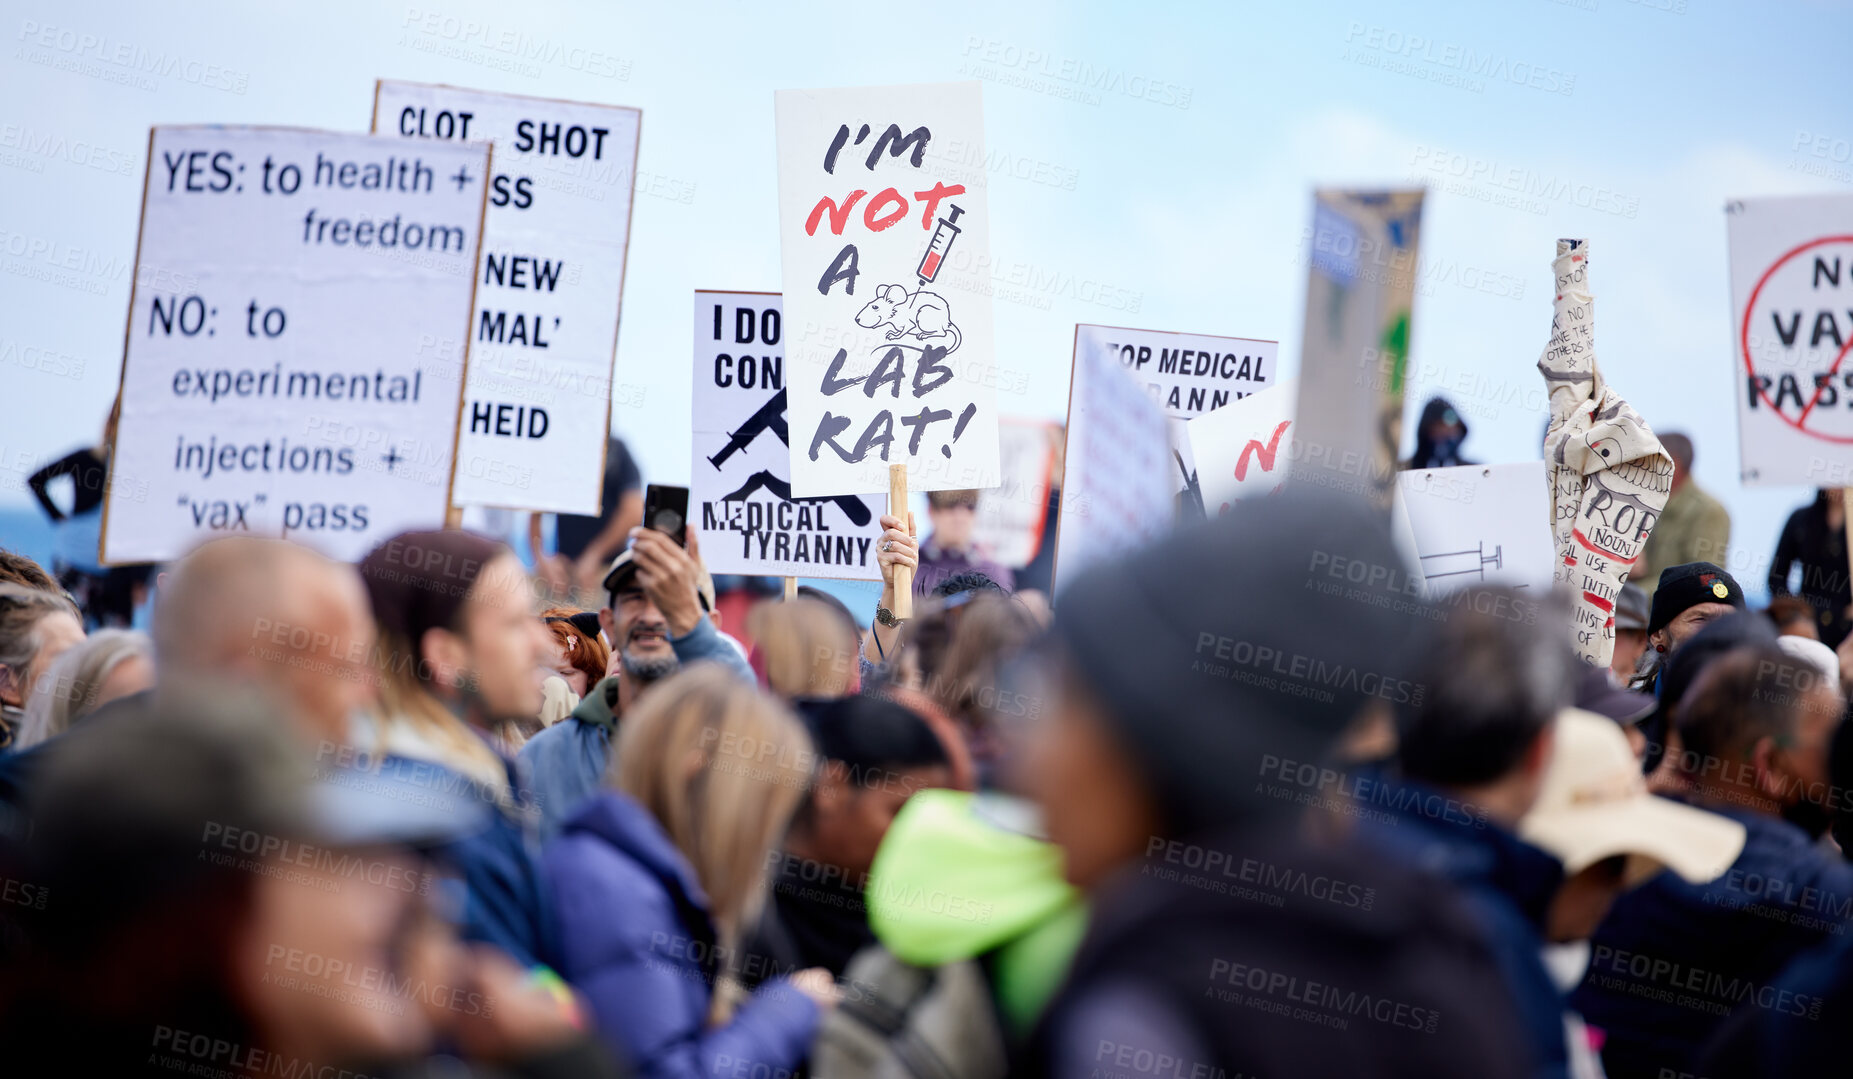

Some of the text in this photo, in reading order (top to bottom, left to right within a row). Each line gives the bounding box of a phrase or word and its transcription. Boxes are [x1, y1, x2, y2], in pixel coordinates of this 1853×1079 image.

[400, 106, 609, 160] CLOT SHOT
[163, 151, 245, 193] YES:
[262, 156, 303, 195] to
[313, 153, 434, 193] health
[805, 181, 966, 236] NOT
[303, 207, 465, 251] freedom
[485, 253, 563, 292] NEW
[818, 244, 860, 296] A
[1813, 257, 1853, 289] N
[148, 296, 287, 337] NO: to
[713, 304, 781, 345] I DO
[1772, 311, 1853, 346] VA
[1158, 347, 1267, 382] MEDICAL
[1547, 341, 1584, 361] OTHERS
[172, 362, 421, 404] experimental
[714, 354, 782, 390] CON
[820, 344, 954, 399] LAB
[471, 402, 550, 439] HEID
[808, 403, 977, 464] RAT!
[175, 435, 354, 478] injections
[283, 501, 370, 539] pass
[702, 501, 830, 531] MEDICAL
[741, 529, 872, 567] TYRANNY
[1586, 553, 1608, 574] USE
[1577, 631, 1595, 645] OF
